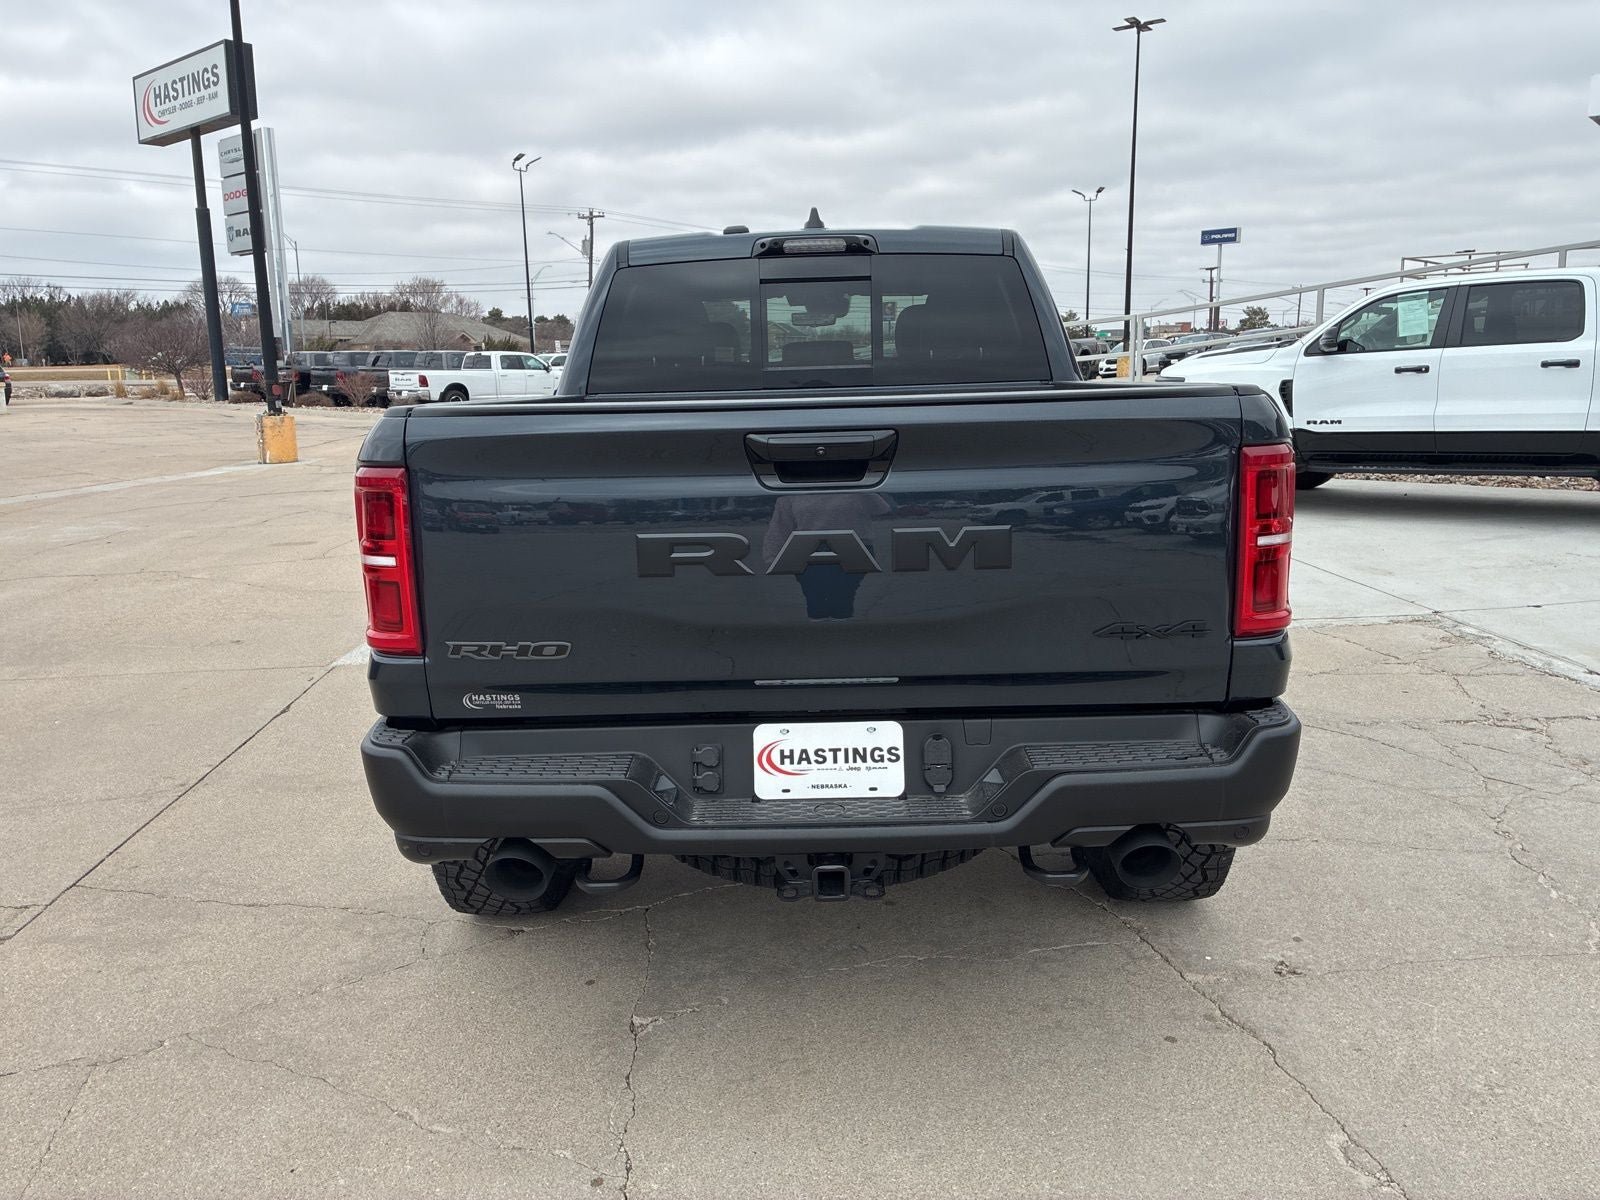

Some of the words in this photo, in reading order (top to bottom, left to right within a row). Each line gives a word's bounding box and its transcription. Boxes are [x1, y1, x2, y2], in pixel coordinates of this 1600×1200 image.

[153, 63, 220, 107] HASTINGS
[223, 189, 248, 201] DODG
[235, 227, 250, 238] RA
[636, 525, 1012, 577] RAM
[445, 641, 571, 659] RHO
[779, 746, 901, 766] HASTINGS
